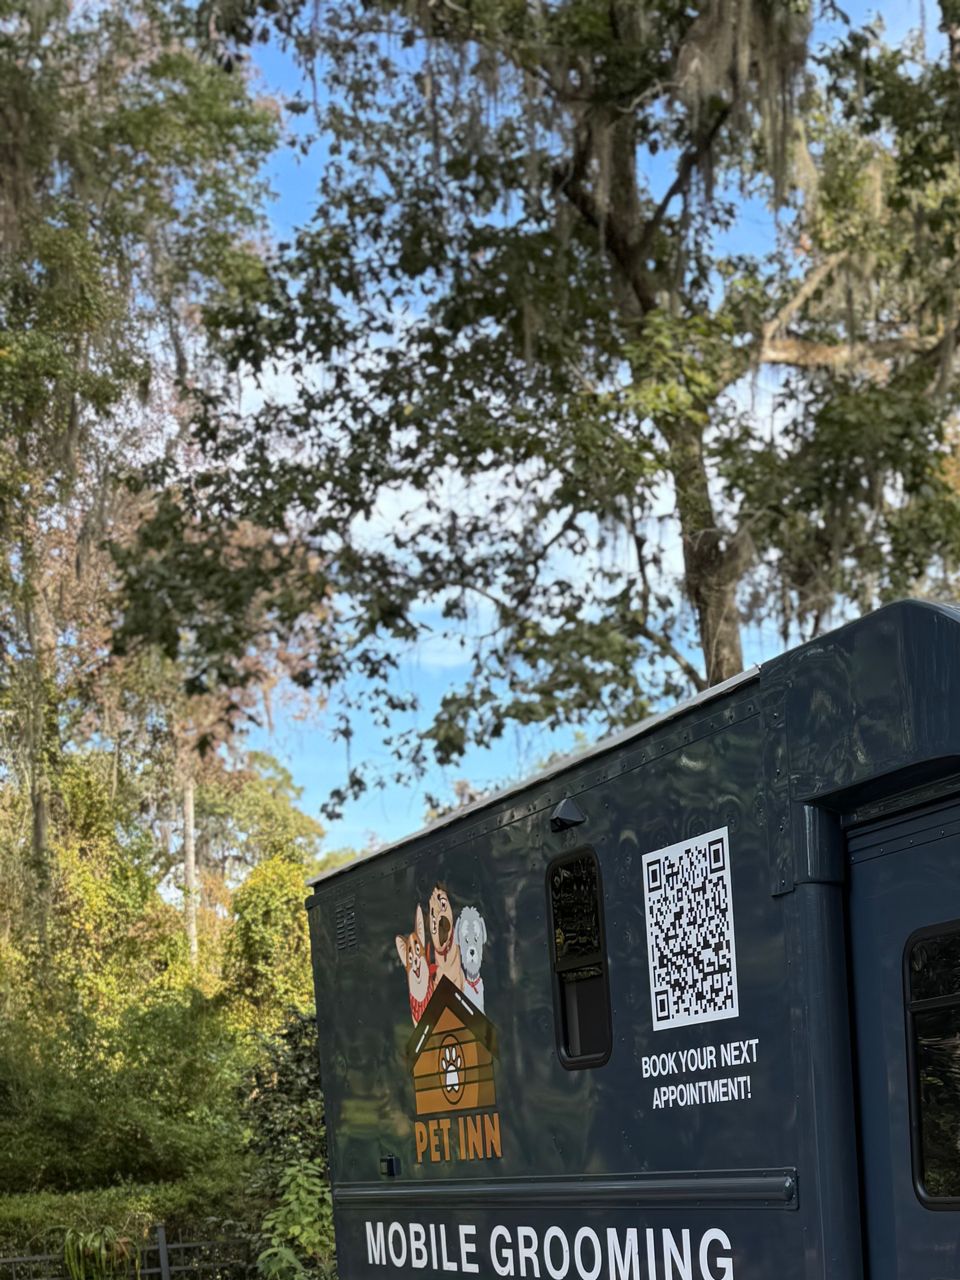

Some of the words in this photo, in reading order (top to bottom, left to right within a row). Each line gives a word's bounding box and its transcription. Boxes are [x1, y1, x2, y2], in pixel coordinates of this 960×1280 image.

[641, 1052, 679, 1079] BOOK
[678, 1045, 717, 1073] YOUR
[720, 1038, 760, 1068] NEXT
[652, 1075, 752, 1110] APPOINTMENT!
[414, 1118, 451, 1163] PET
[458, 1112, 502, 1160] INN
[365, 1221, 480, 1274] MOBILE
